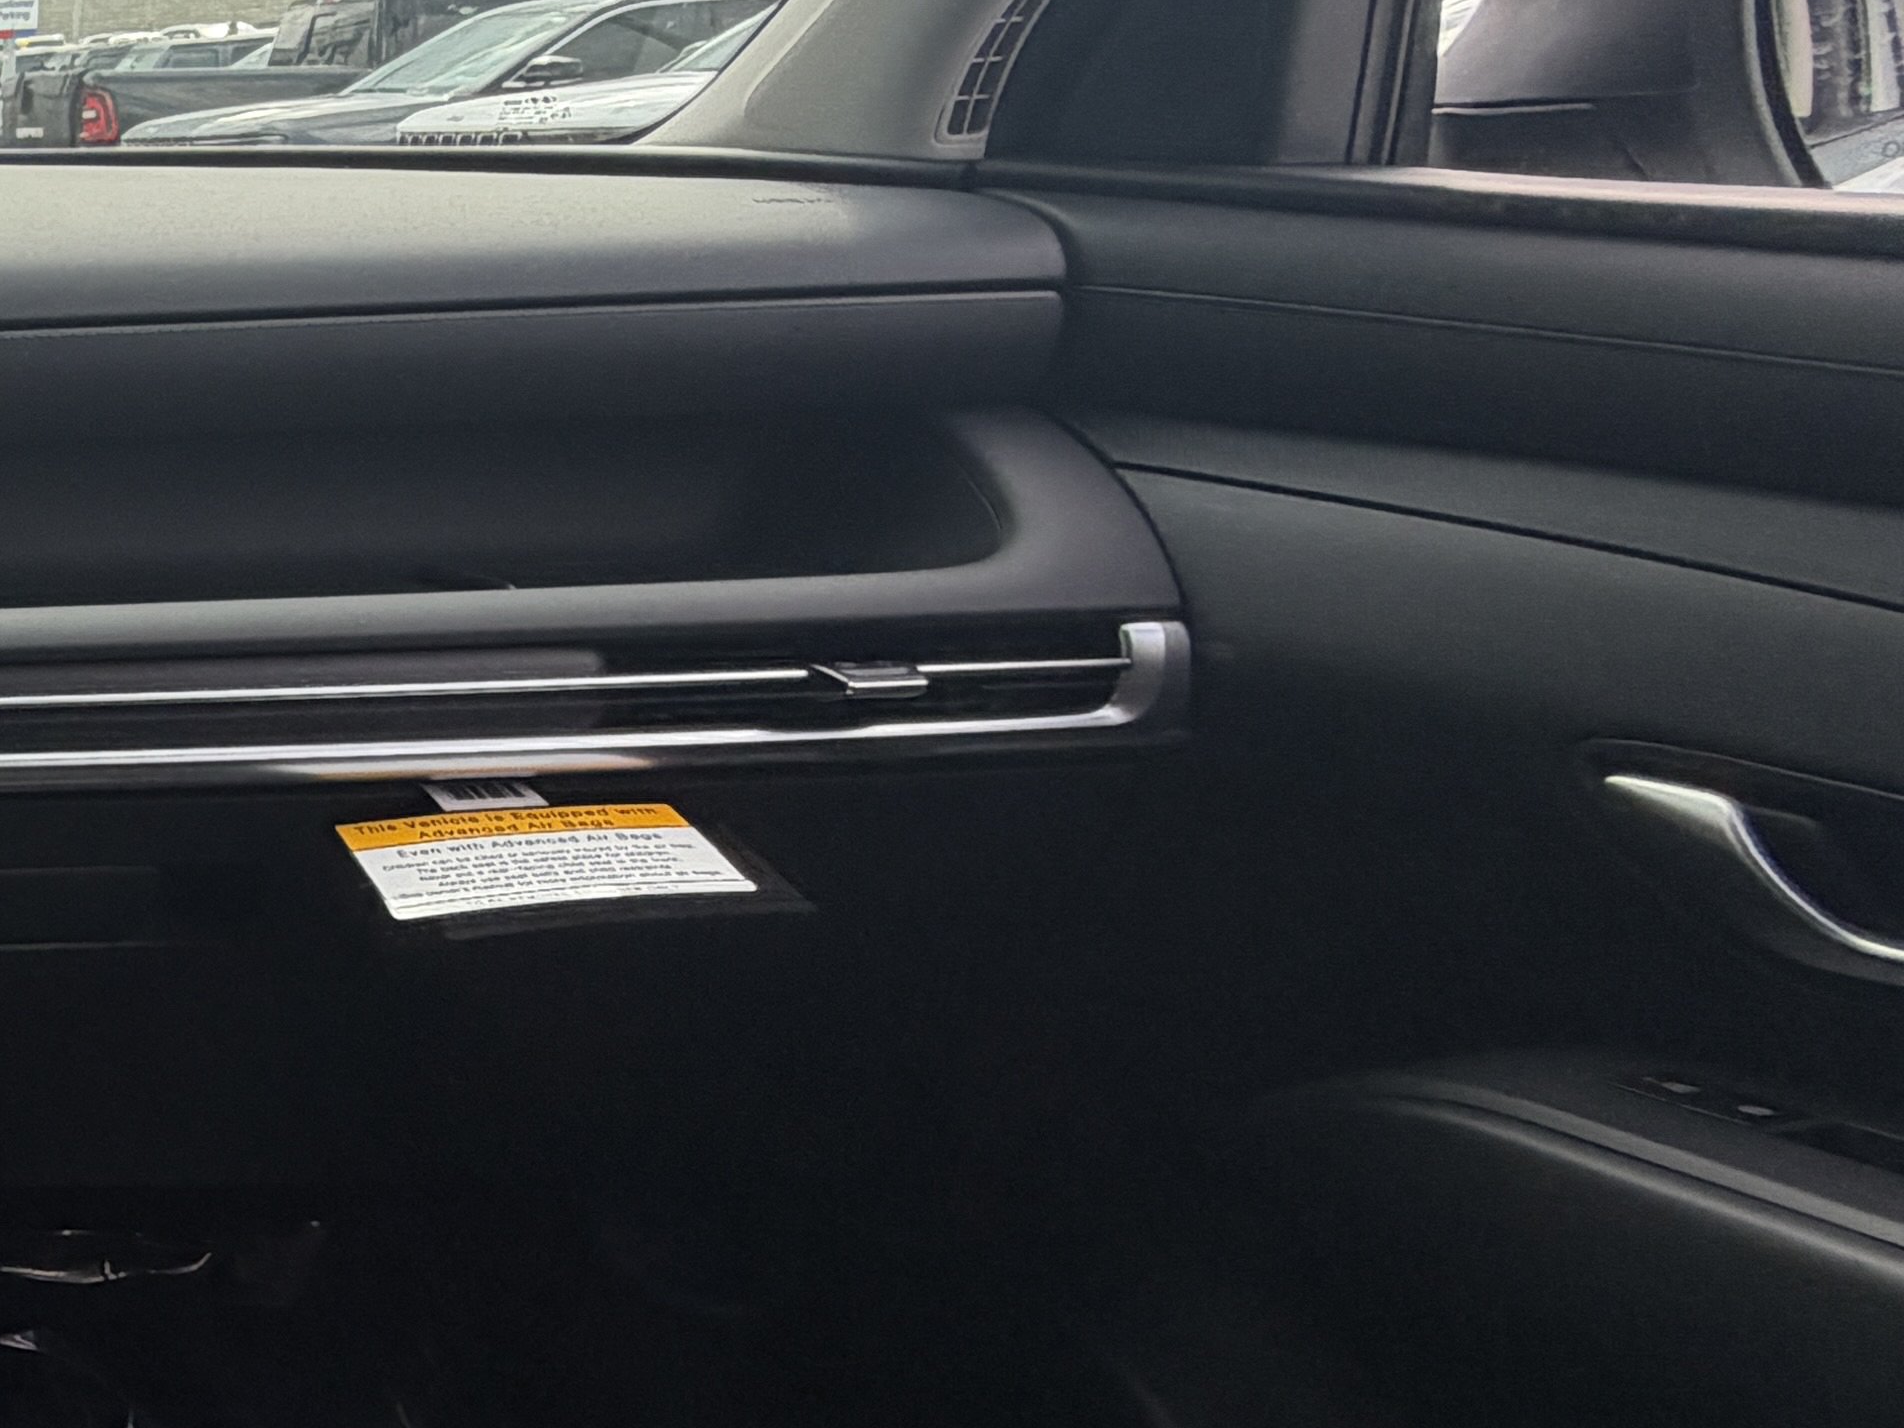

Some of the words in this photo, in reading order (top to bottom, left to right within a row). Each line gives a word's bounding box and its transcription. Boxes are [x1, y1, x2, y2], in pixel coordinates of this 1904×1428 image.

[510, 807, 610, 821] Equipped
[418, 823, 520, 840] Advanced
[528, 821, 553, 831] Air
[396, 848, 442, 859] Even
[447, 843, 485, 853] with
[492, 835, 580, 848] Advanced
[586, 834, 609, 843] Air
